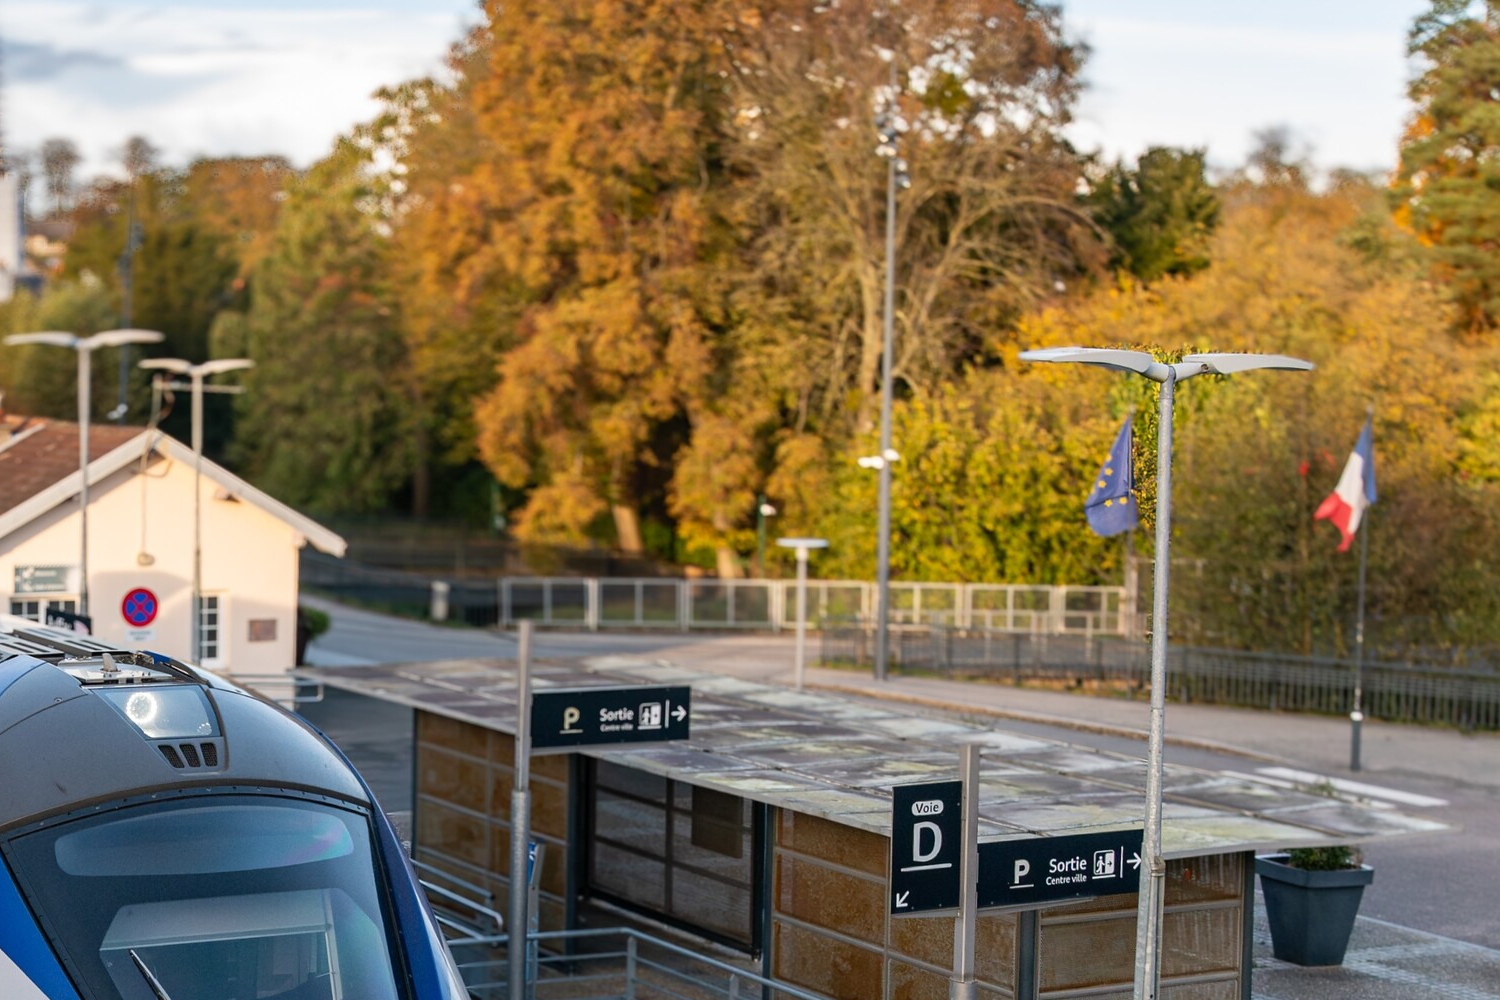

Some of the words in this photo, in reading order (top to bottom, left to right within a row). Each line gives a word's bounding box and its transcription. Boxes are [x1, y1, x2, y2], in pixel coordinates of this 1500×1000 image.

[599, 707, 634, 721] Sortie
[915, 802, 940, 814] Voie
[912, 821, 943, 863] D
[1013, 859, 1030, 884] P
[1049, 856, 1087, 873] Sortie
[1045, 876, 1071, 886] Centre
[1071, 873, 1087, 883] ville
